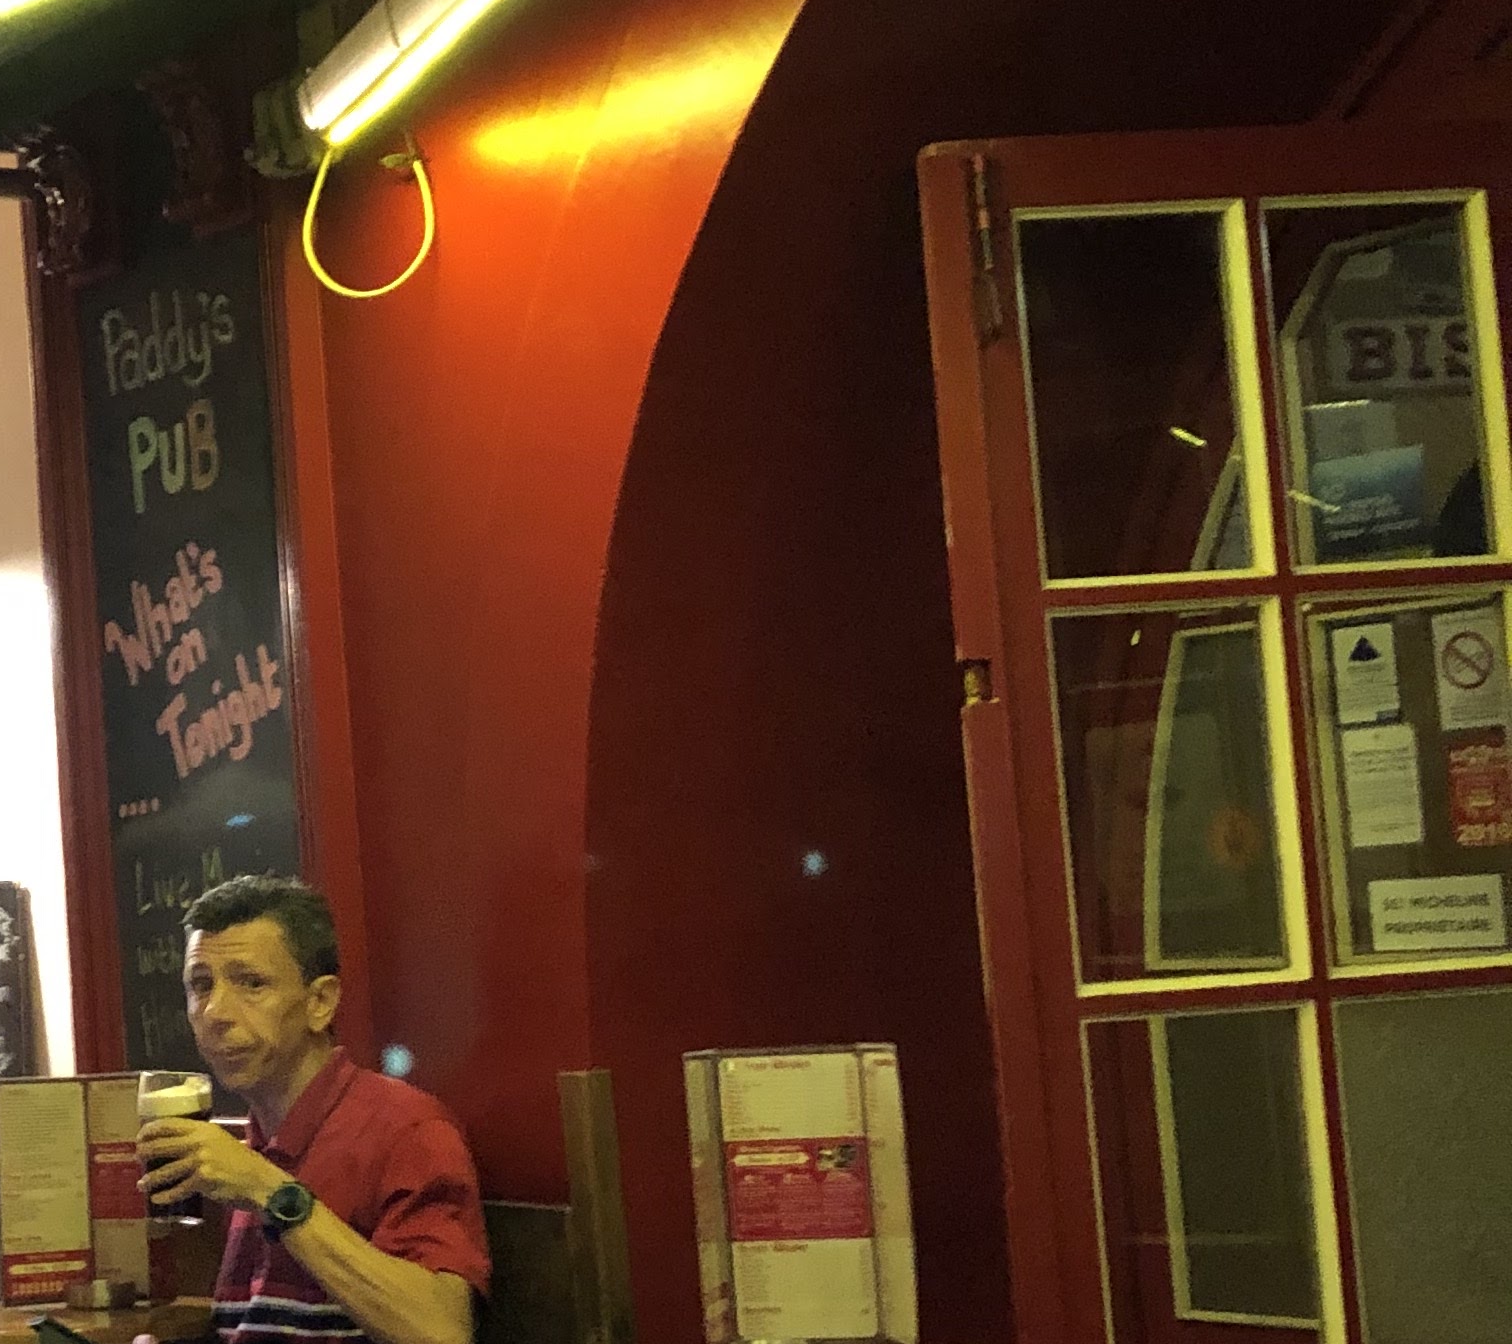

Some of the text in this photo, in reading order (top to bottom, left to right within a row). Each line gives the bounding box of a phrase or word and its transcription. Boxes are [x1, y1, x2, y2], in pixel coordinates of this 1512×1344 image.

[100, 289, 234, 396] Paddy's
[104, 541, 223, 686] What's
[166, 627, 206, 685] on
[155, 644, 282, 779] Tonight
